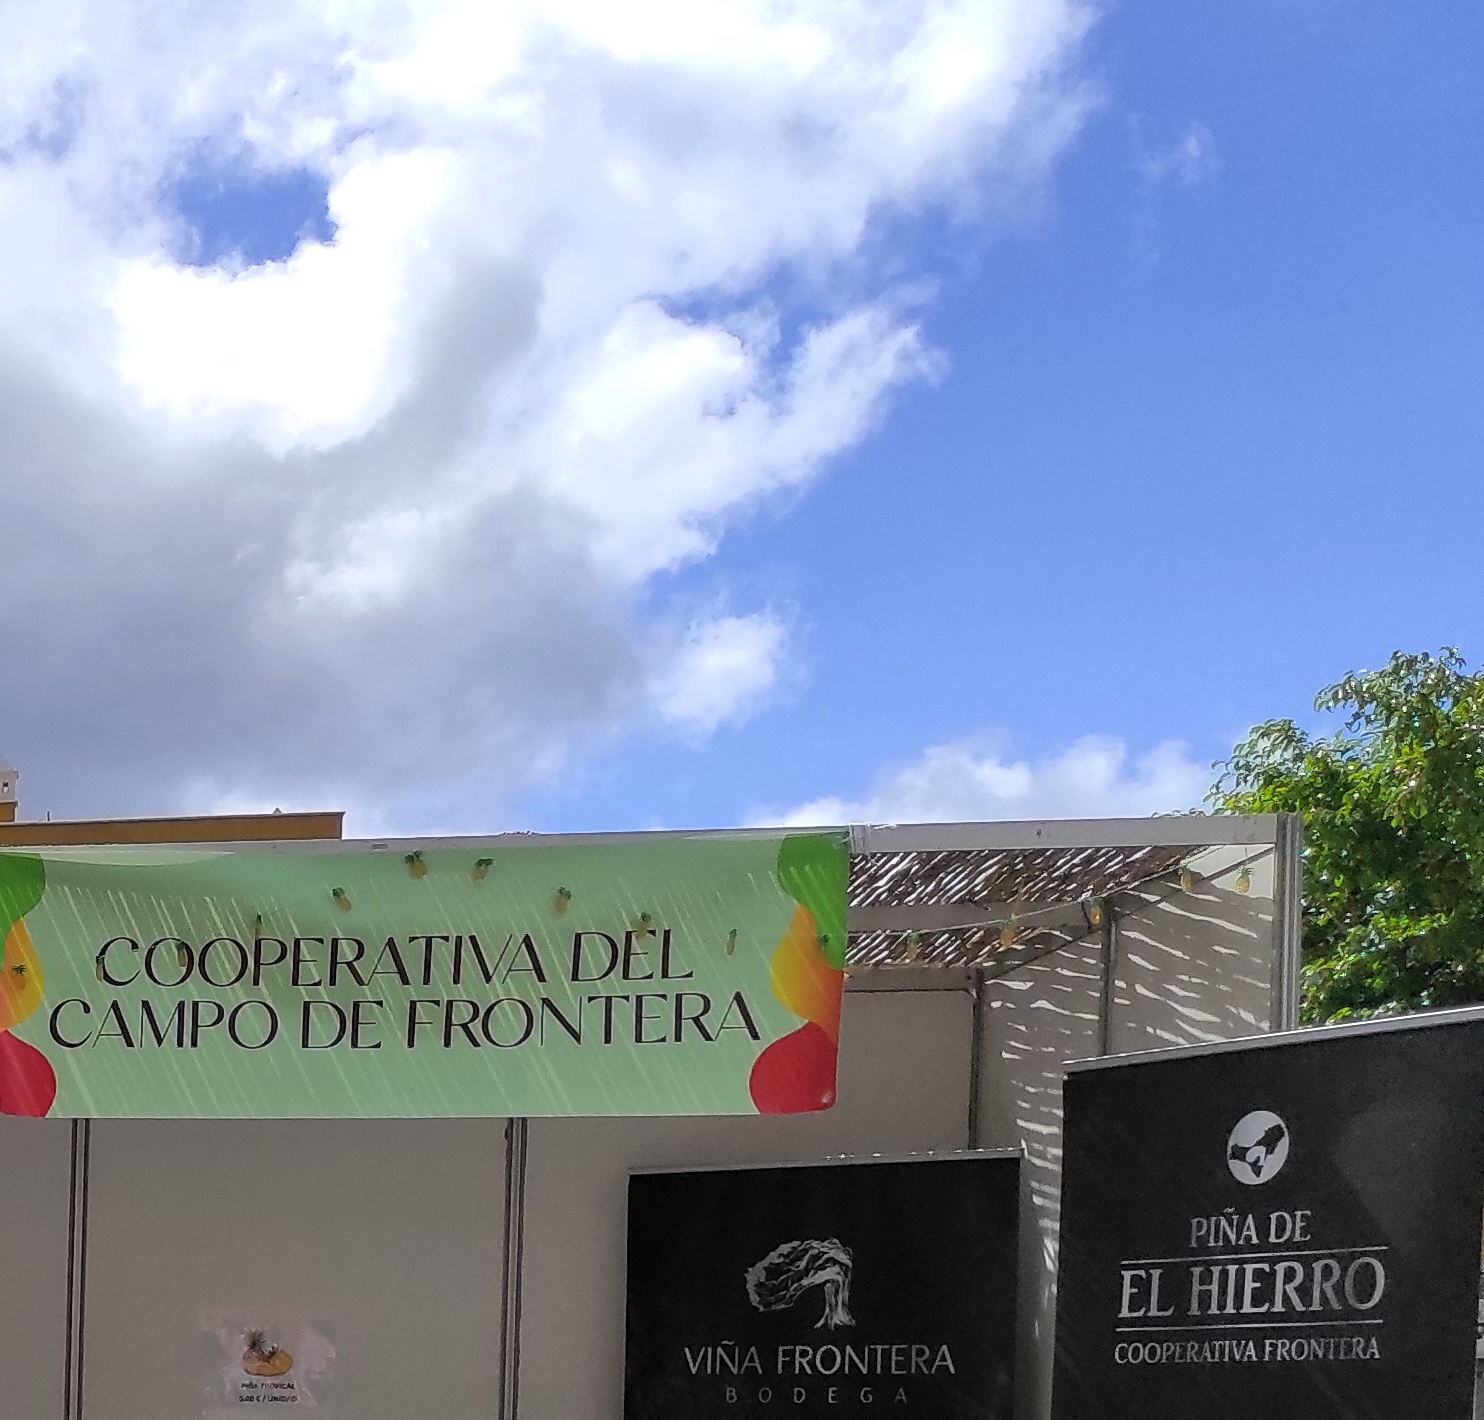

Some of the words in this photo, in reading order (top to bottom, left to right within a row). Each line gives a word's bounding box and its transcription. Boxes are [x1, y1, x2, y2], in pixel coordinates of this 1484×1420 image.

[97, 931, 550, 989] COOPERATIVA
[569, 929, 694, 984] DEL
[48, 996, 280, 1051] CAMPO
[301, 998, 383, 1050] DE
[405, 991, 763, 1051] FRONTERA
[1189, 1206, 1260, 1248] PIÑA
[1268, 1210, 1312, 1244] DE
[1117, 1269, 1175, 1319] EL
[1187, 1256, 1386, 1316] HIERRO
[684, 1340, 763, 1375] VIÑA
[777, 1344, 956, 1375] FRONTERA
[1114, 1338, 1259, 1364] COOPERATIVA
[1263, 1336, 1381, 1362] FRONTERA
[725, 1387, 907, 1404] BODEGA
